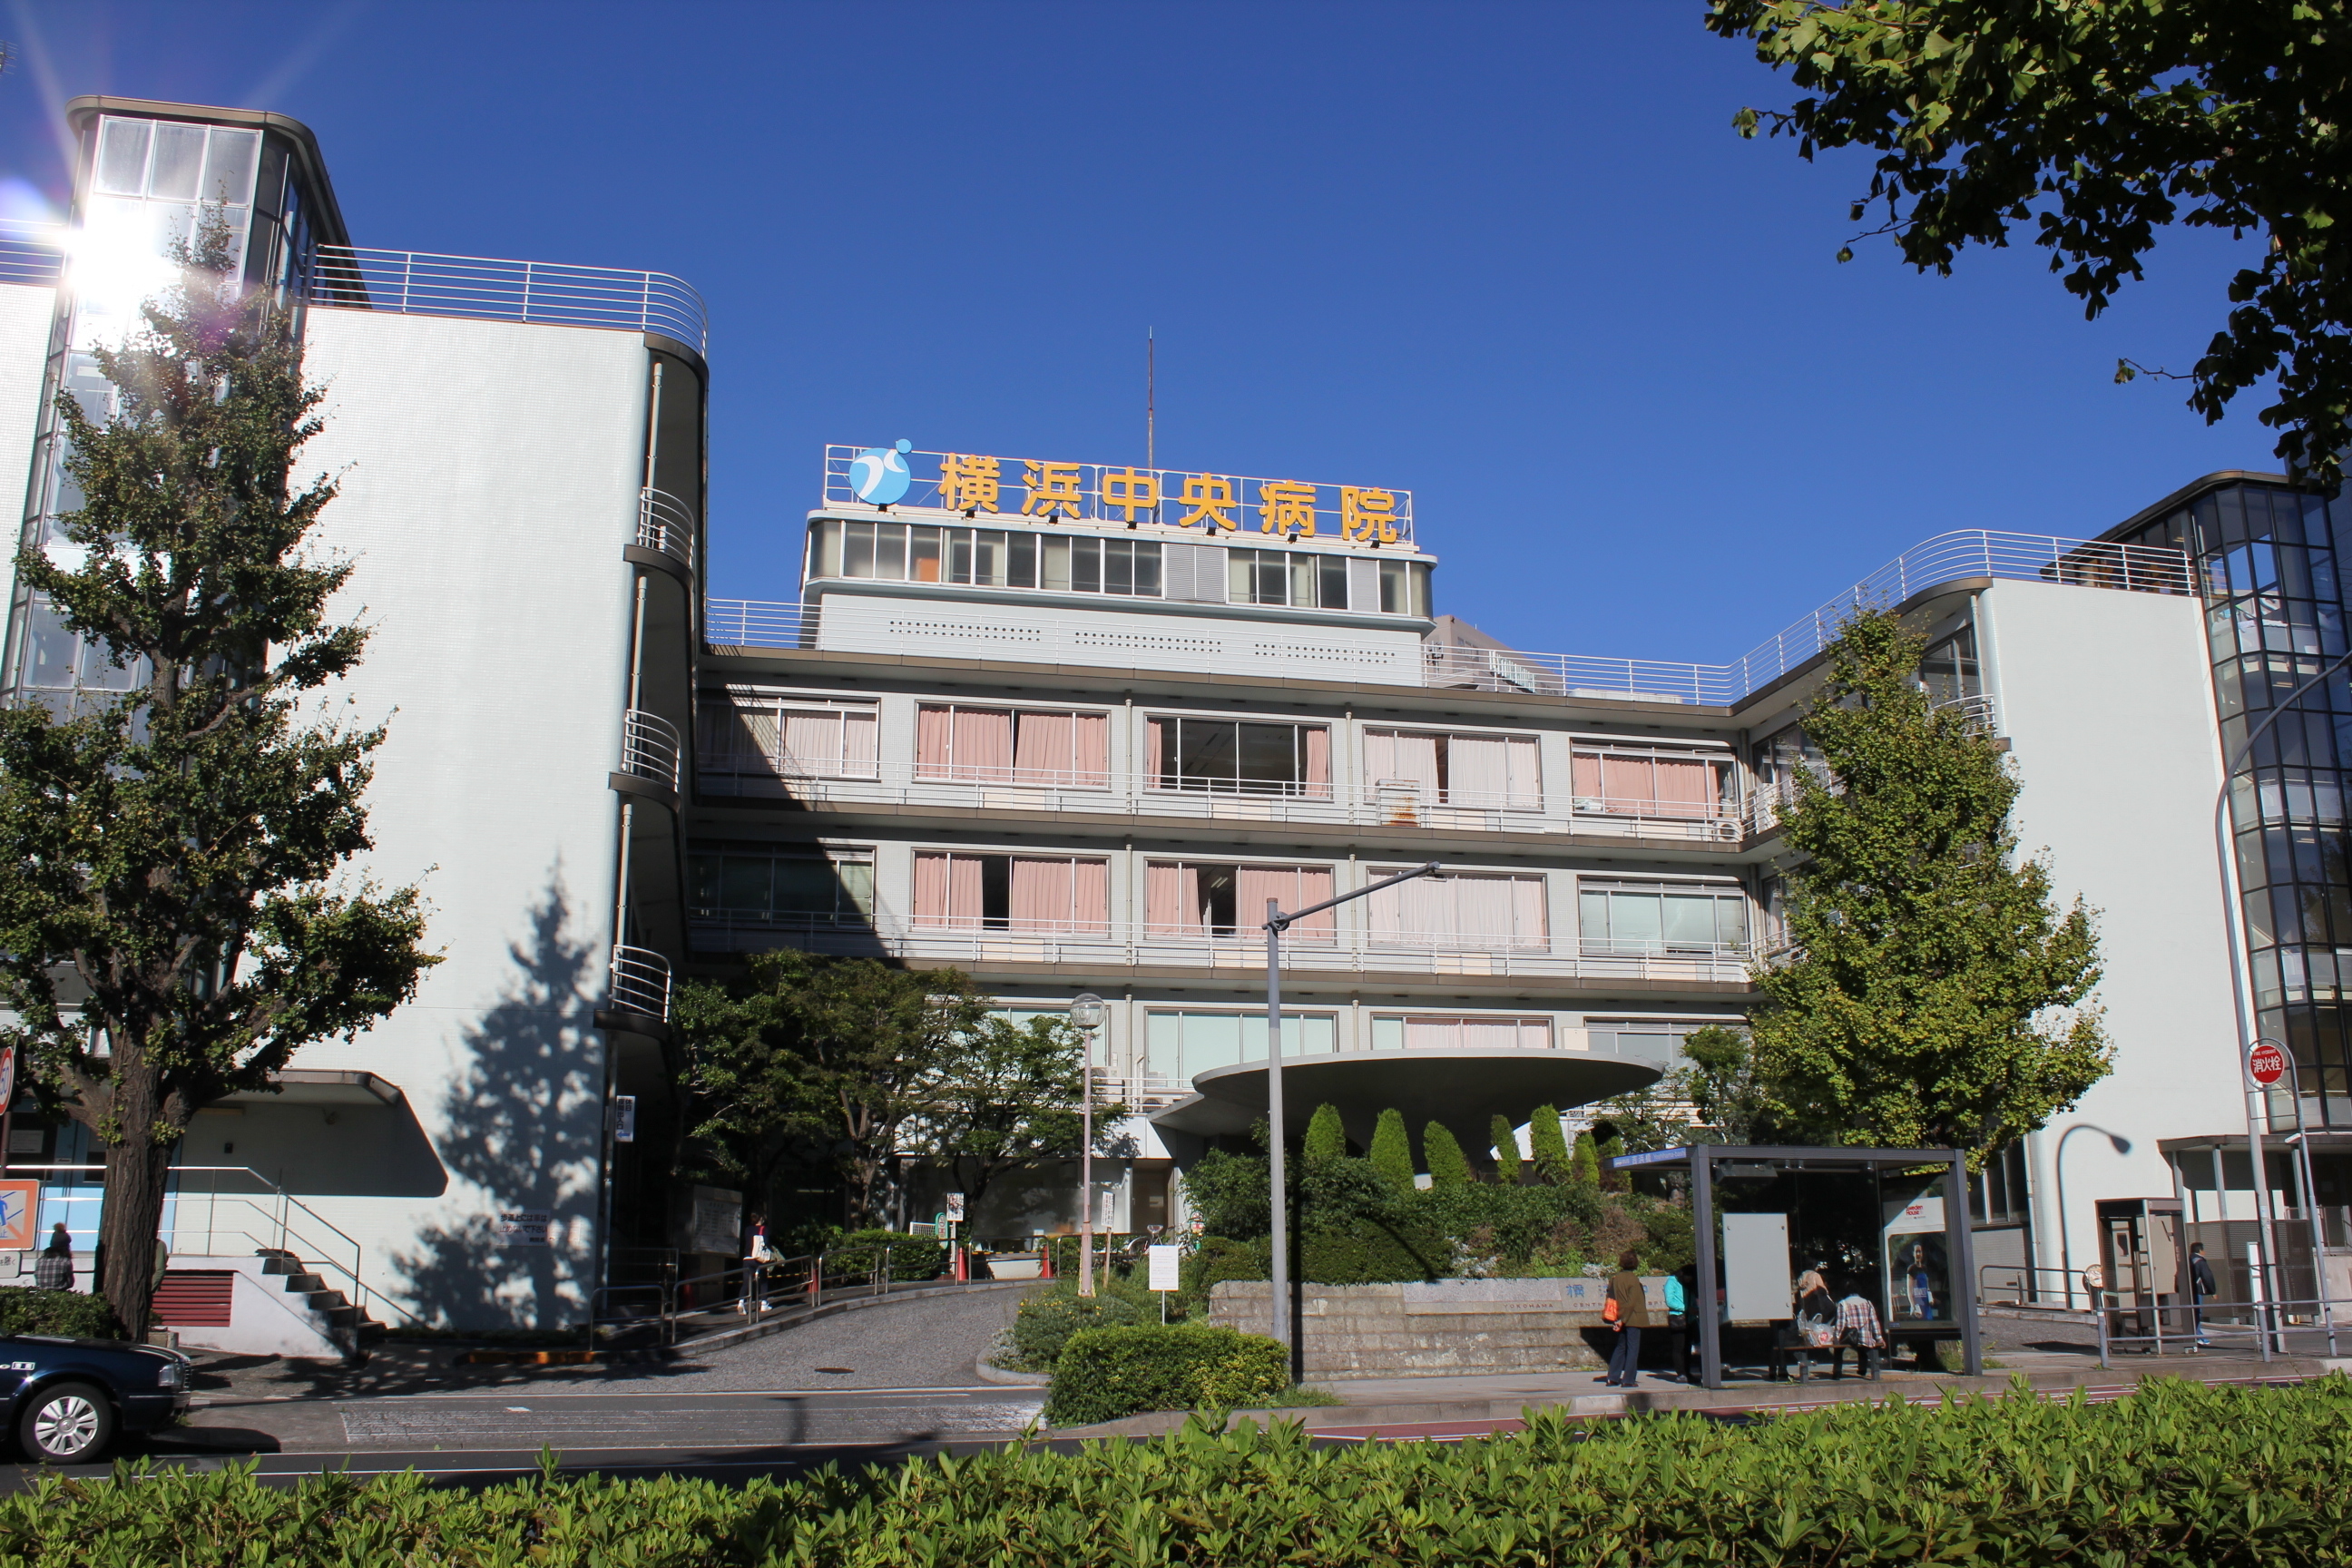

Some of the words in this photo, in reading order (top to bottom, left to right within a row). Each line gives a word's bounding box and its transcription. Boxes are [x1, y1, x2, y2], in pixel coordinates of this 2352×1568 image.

[938, 452, 1397, 544] 横浜中央病院
[2252, 1055, 2281, 1073] 消火栓
